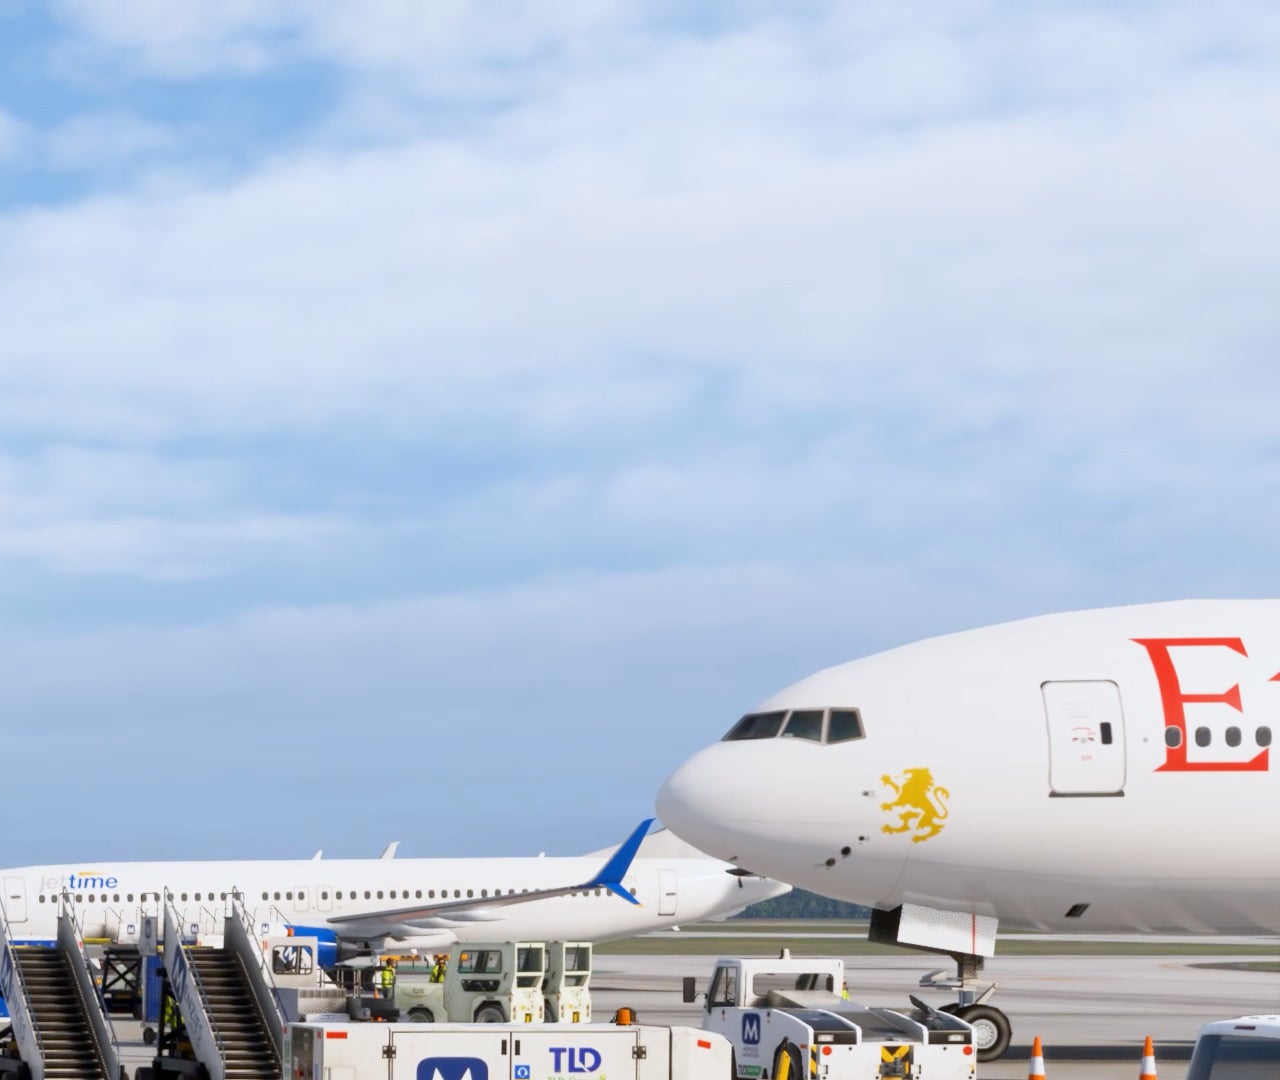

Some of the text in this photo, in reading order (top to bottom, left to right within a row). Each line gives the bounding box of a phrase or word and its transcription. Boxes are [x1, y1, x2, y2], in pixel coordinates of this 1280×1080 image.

[1128, 637, 1280, 772] E
[744, 1019, 759, 1041] M
[548, 1047, 602, 1073] TLD
